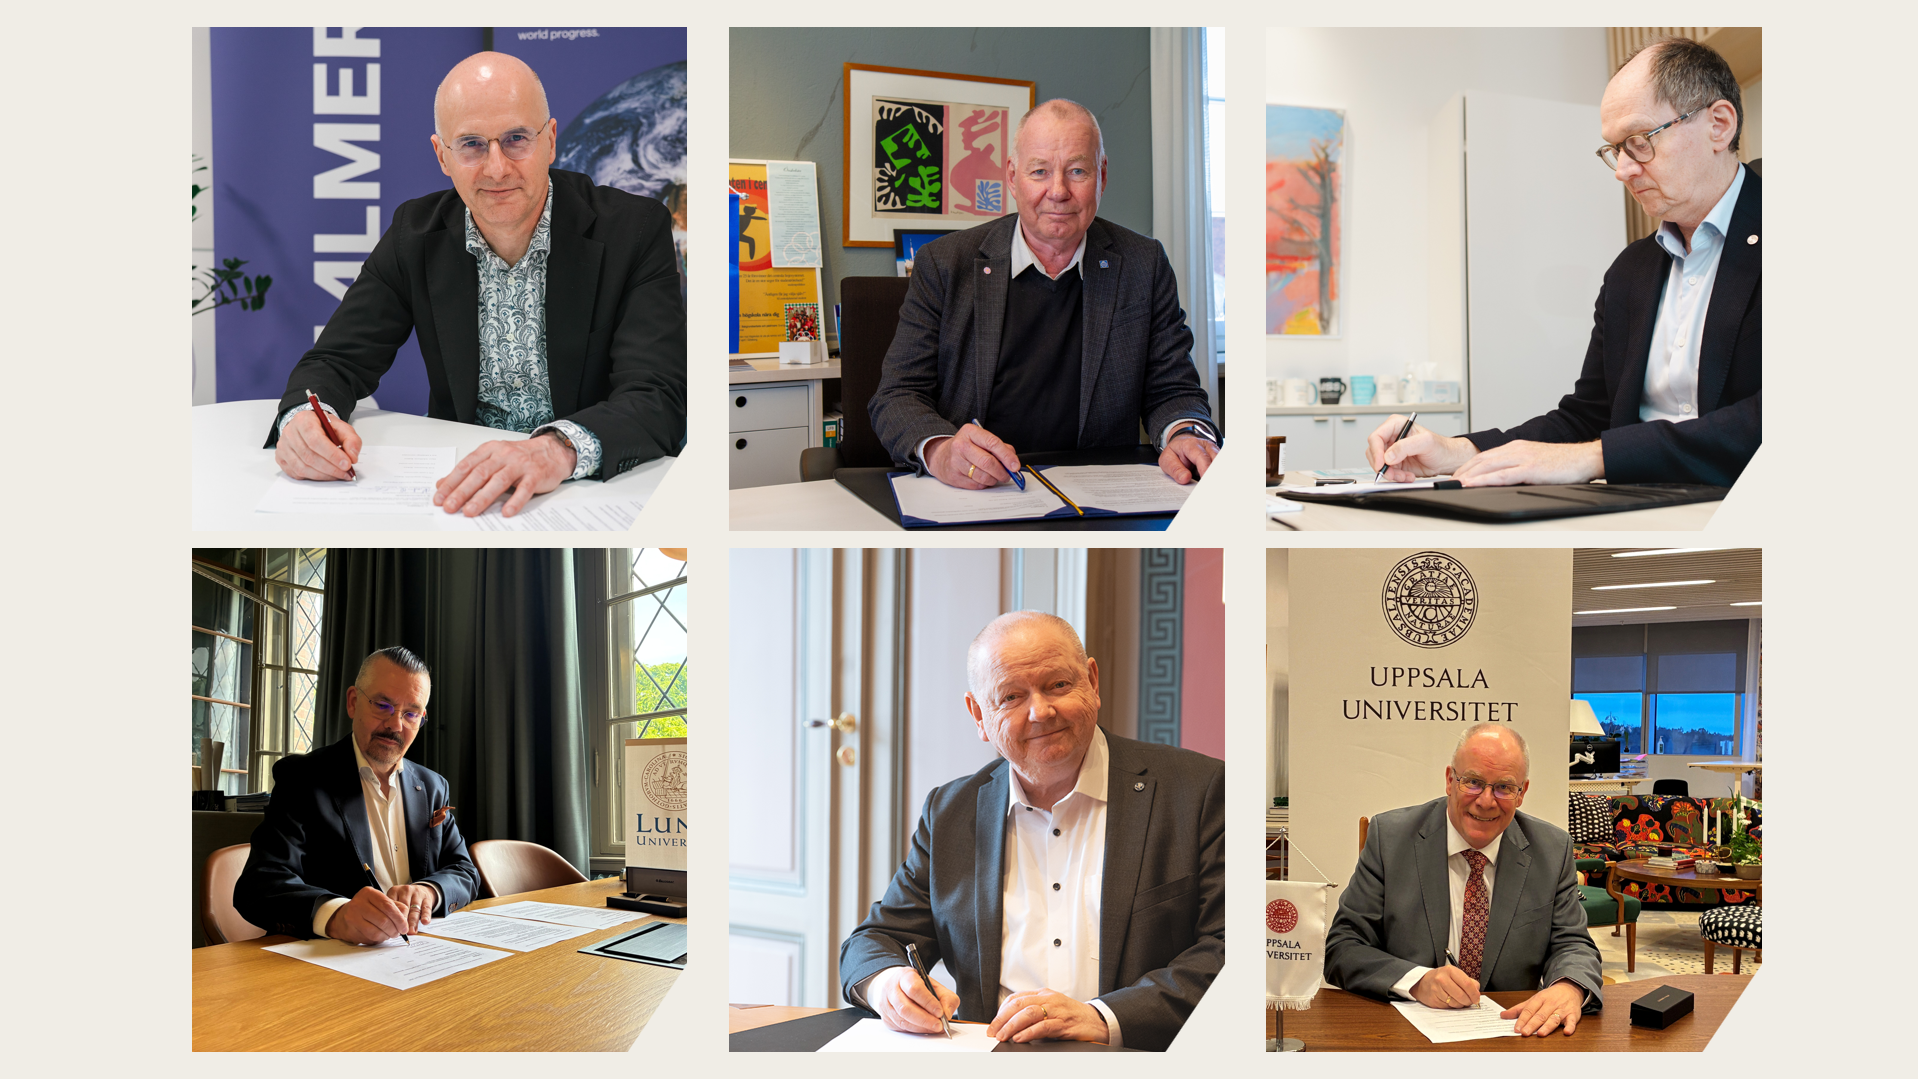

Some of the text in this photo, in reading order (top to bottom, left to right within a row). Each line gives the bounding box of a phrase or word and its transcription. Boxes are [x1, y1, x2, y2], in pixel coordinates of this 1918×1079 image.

[517, 28, 600, 41] world progress.
[729, 177, 746, 189] ten
[1404, 570, 1456, 591] GRATIAE
[1404, 597, 1455, 605] VERITAS
[1404, 611, 1456, 630] NATURAE
[1370, 666, 1490, 689] UPPSALA
[1342, 699, 1519, 722] UNIVERSITET
[636, 835, 687, 847] UNIVER
[1266, 950, 1312, 961] VERSITET
